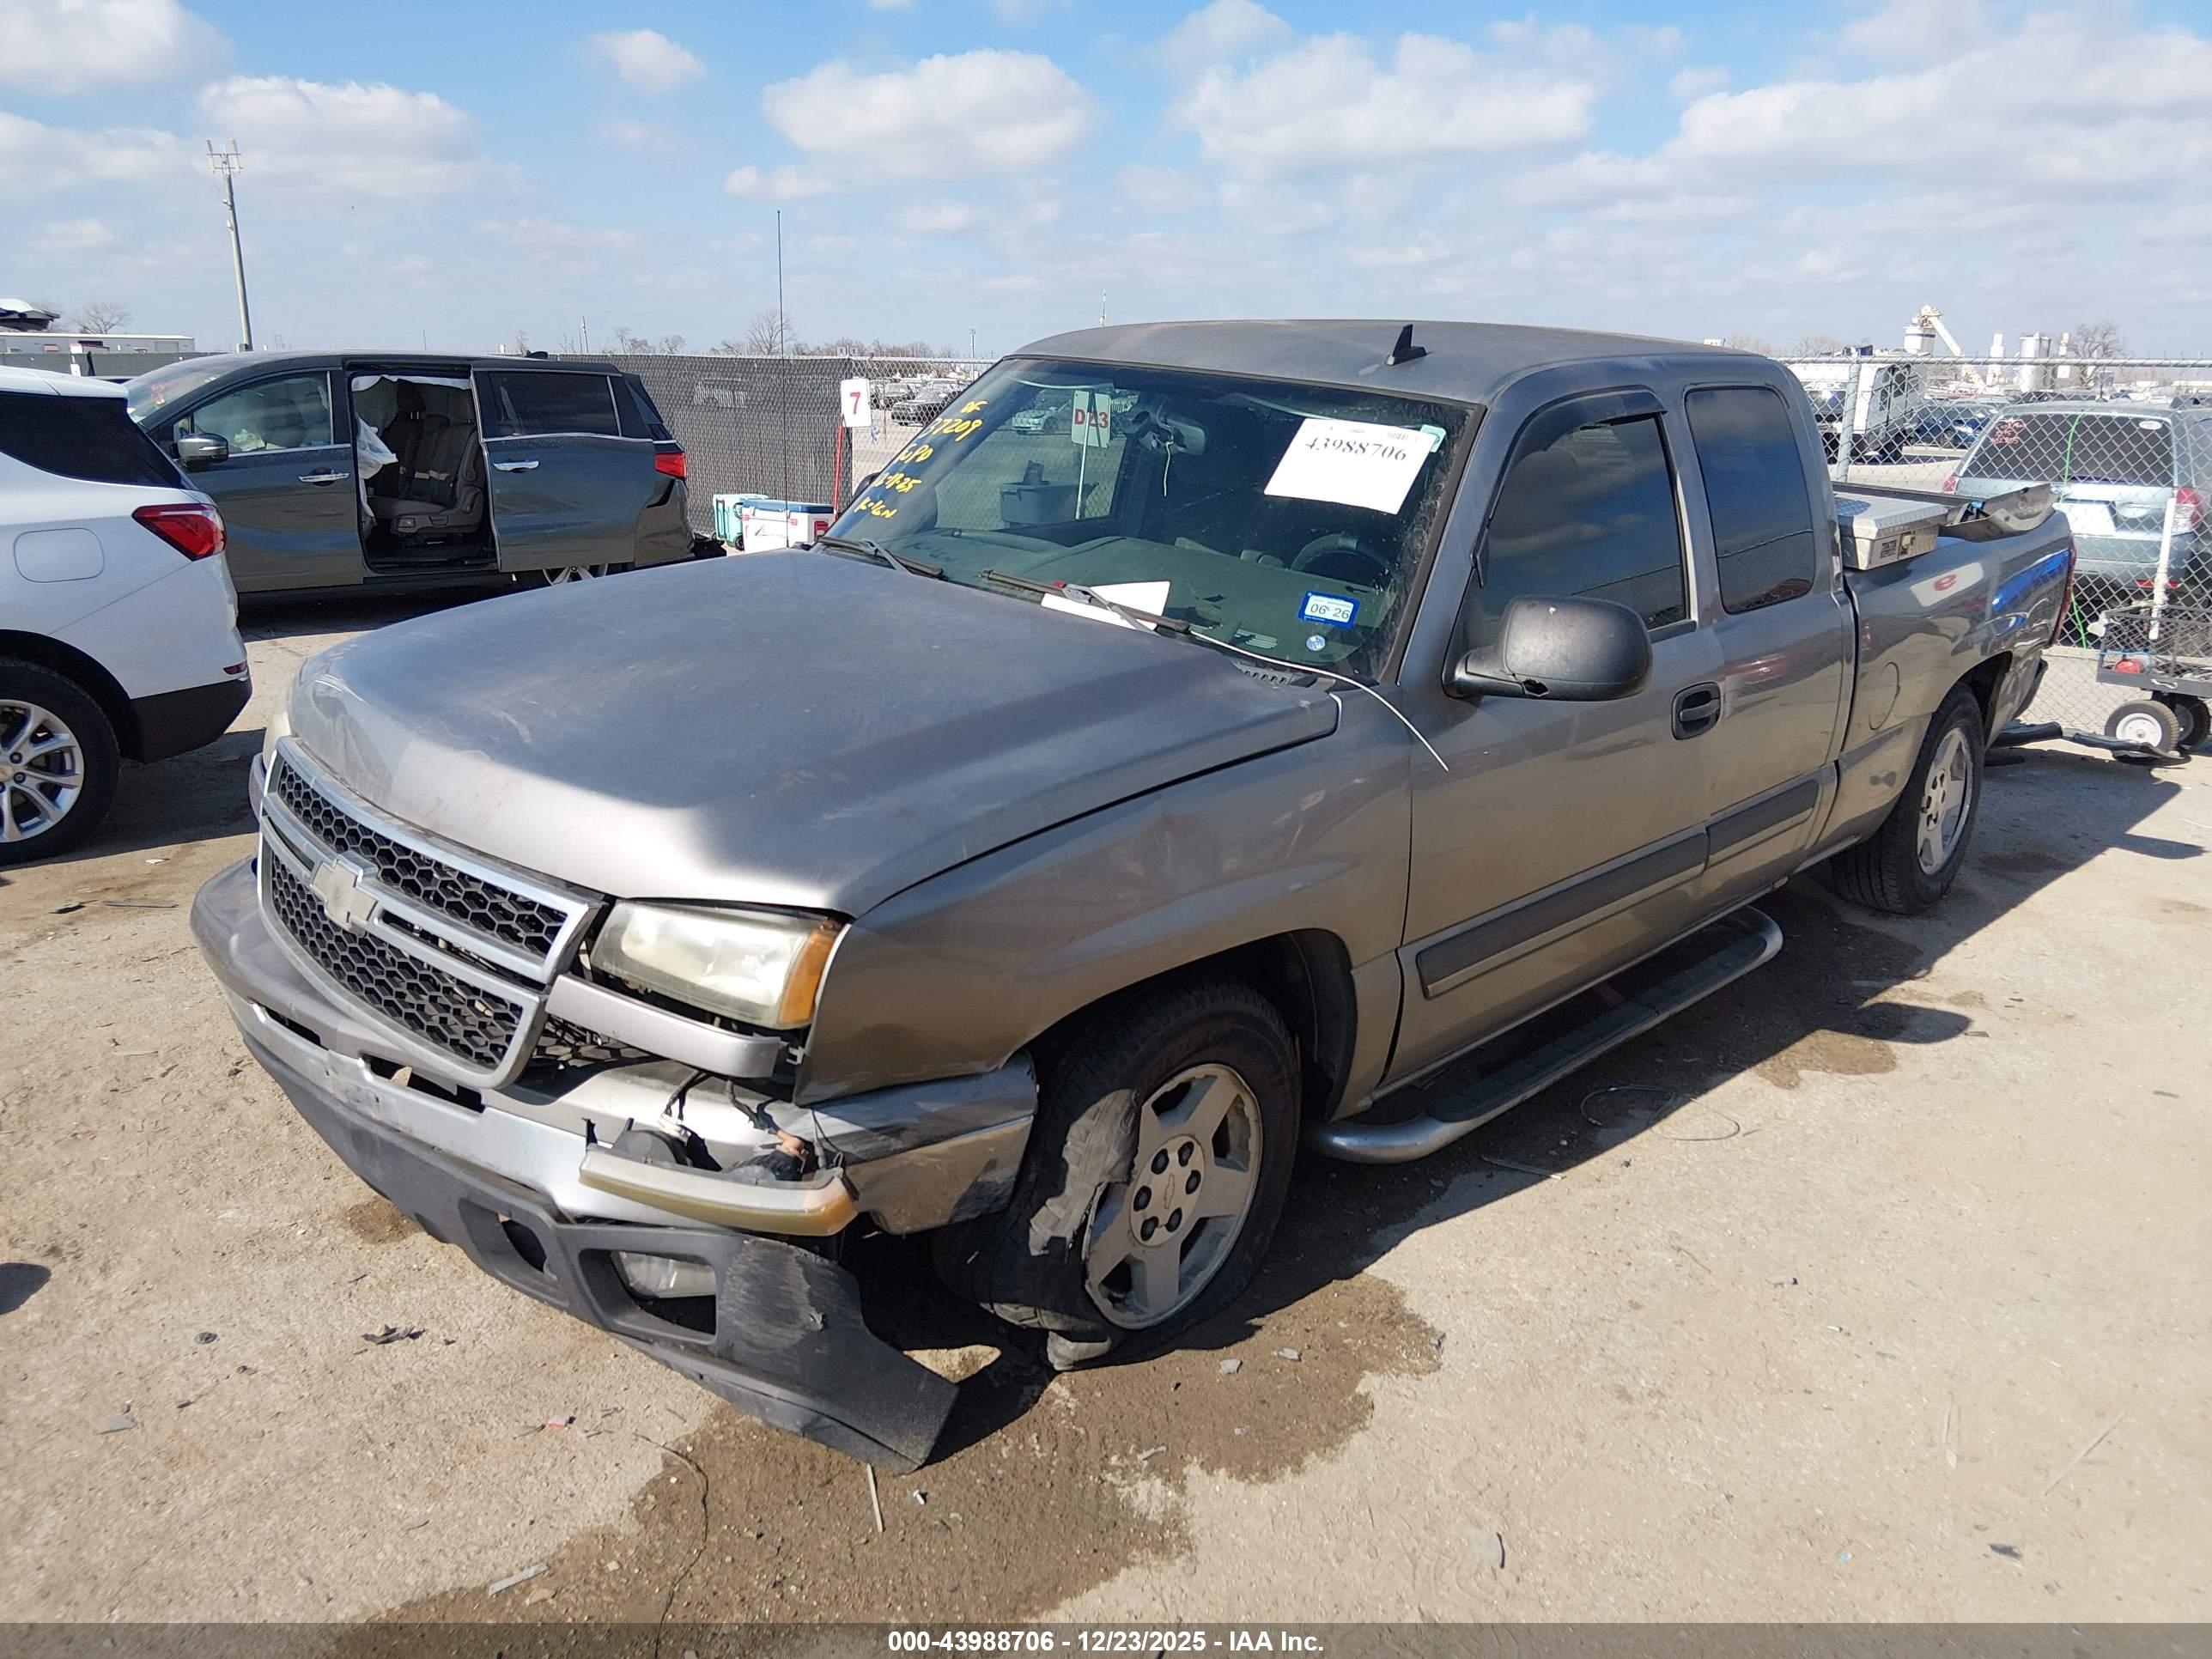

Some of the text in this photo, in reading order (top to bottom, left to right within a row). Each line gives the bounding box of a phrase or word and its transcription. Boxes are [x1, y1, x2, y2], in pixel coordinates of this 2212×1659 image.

[849, 392, 861, 415] 7
[1305, 436, 1407, 461] 43988706
[1310, 603, 1326, 615] 06
[1333, 607, 1351, 620] 26
